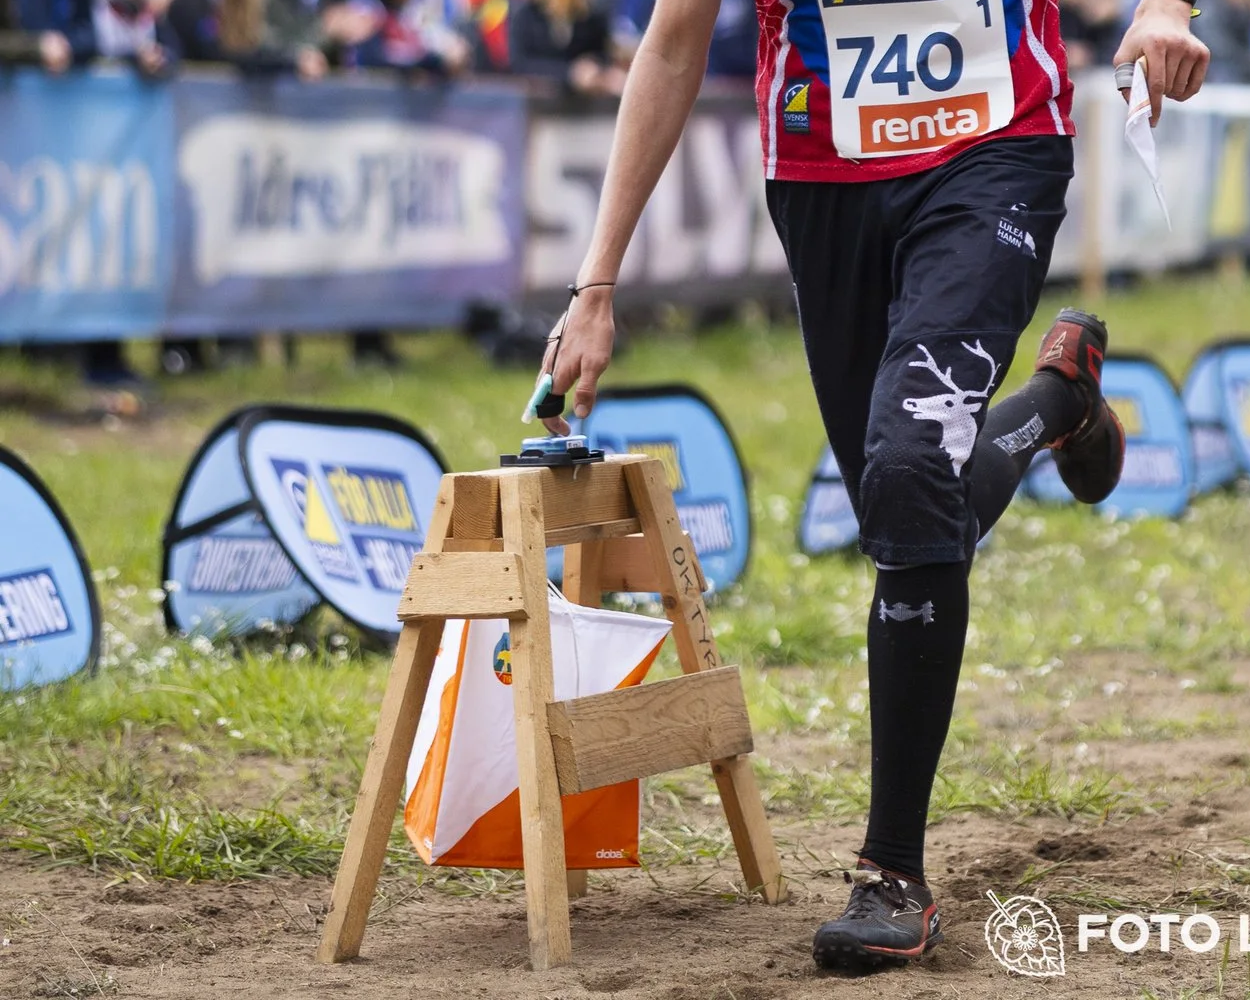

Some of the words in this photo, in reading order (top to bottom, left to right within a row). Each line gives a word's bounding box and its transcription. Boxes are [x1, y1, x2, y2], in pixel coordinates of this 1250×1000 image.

[835, 31, 964, 99] 740
[871, 107, 979, 144] renta
[997, 229, 1022, 248] HAMN
[672, 546, 694, 596] OK
